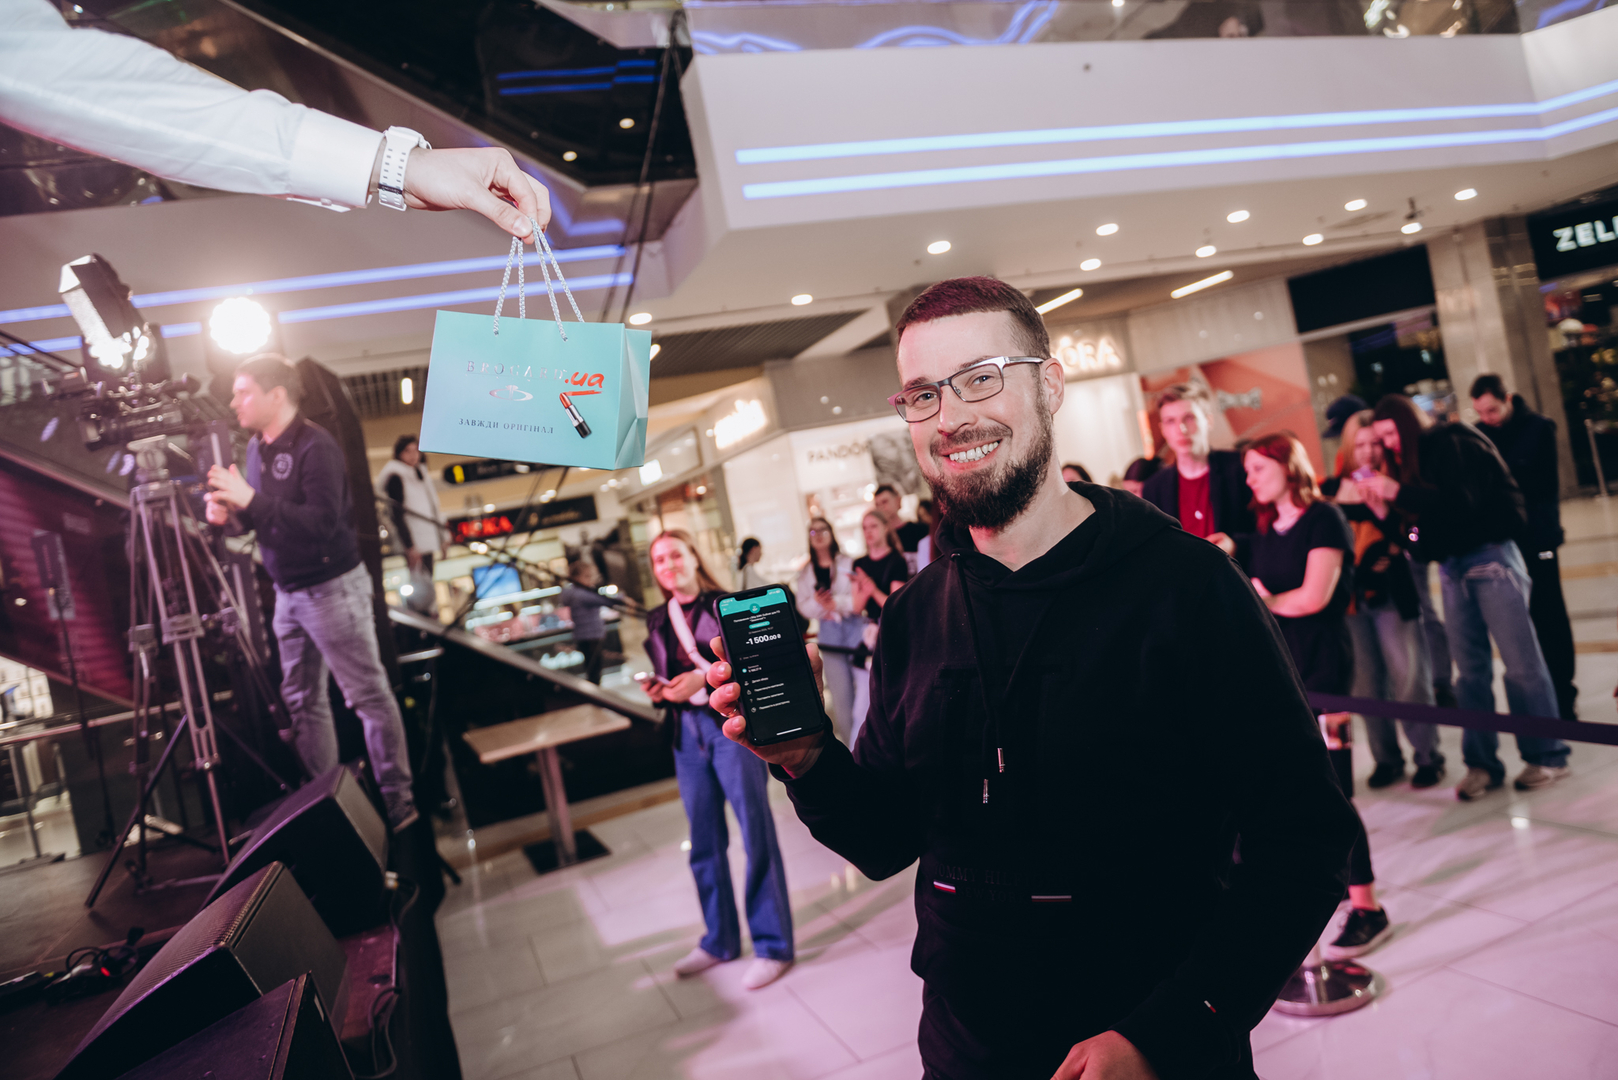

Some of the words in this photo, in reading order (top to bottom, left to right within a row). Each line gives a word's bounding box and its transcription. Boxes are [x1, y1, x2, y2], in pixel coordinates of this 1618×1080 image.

[1050, 336, 1121, 373] ORA
[459, 418, 499, 429] ЗАВЖДИ
[503, 422, 554, 434] ОРИГІНАЛ
[807, 441, 868, 464] PANDO
